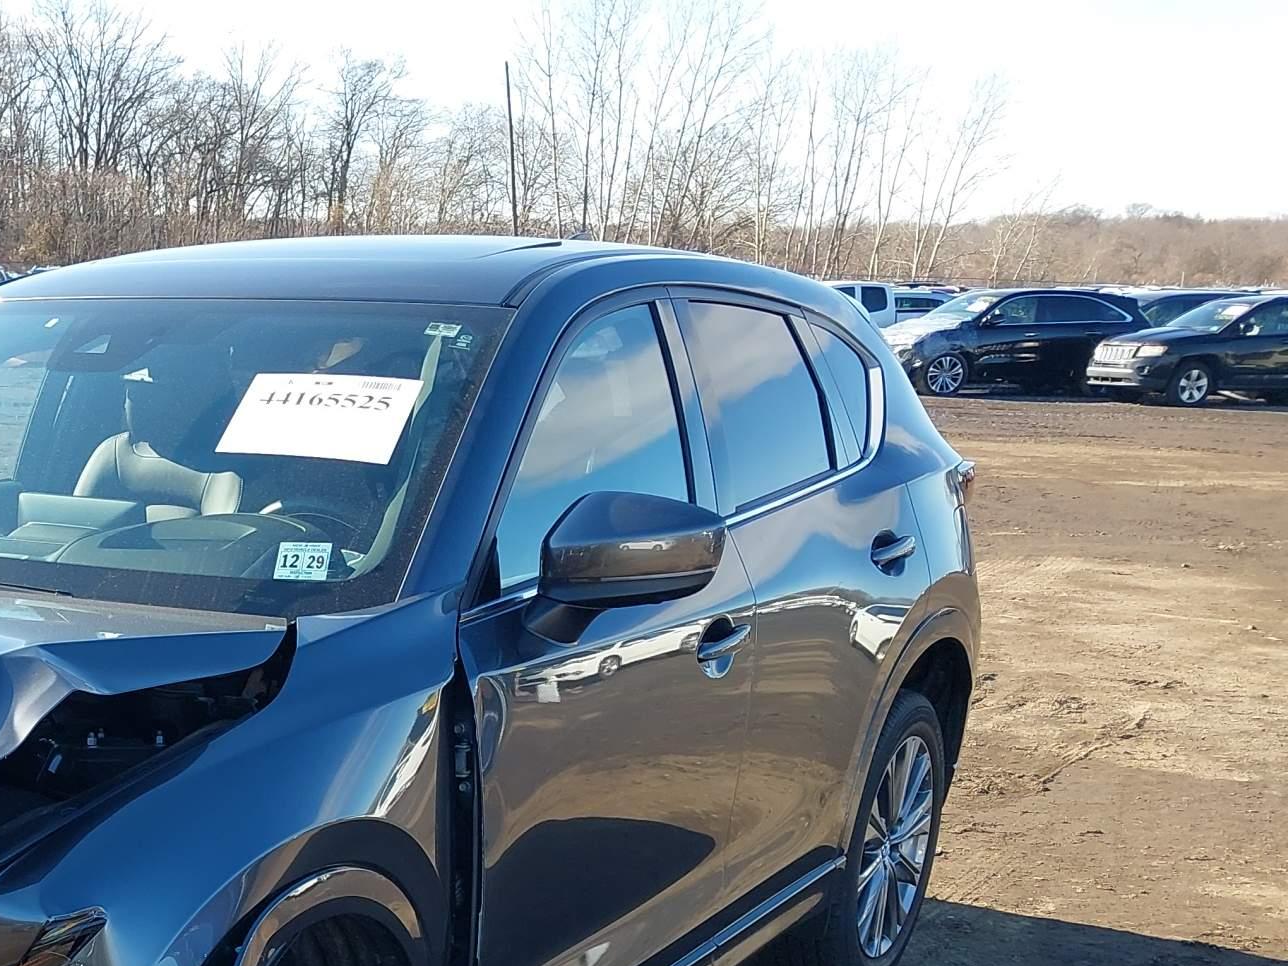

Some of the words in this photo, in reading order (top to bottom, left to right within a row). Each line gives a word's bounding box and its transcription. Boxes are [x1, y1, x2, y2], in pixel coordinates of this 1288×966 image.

[259, 391, 393, 411] 44165525
[280, 553, 300, 569] 12
[306, 555, 325, 570] 29
